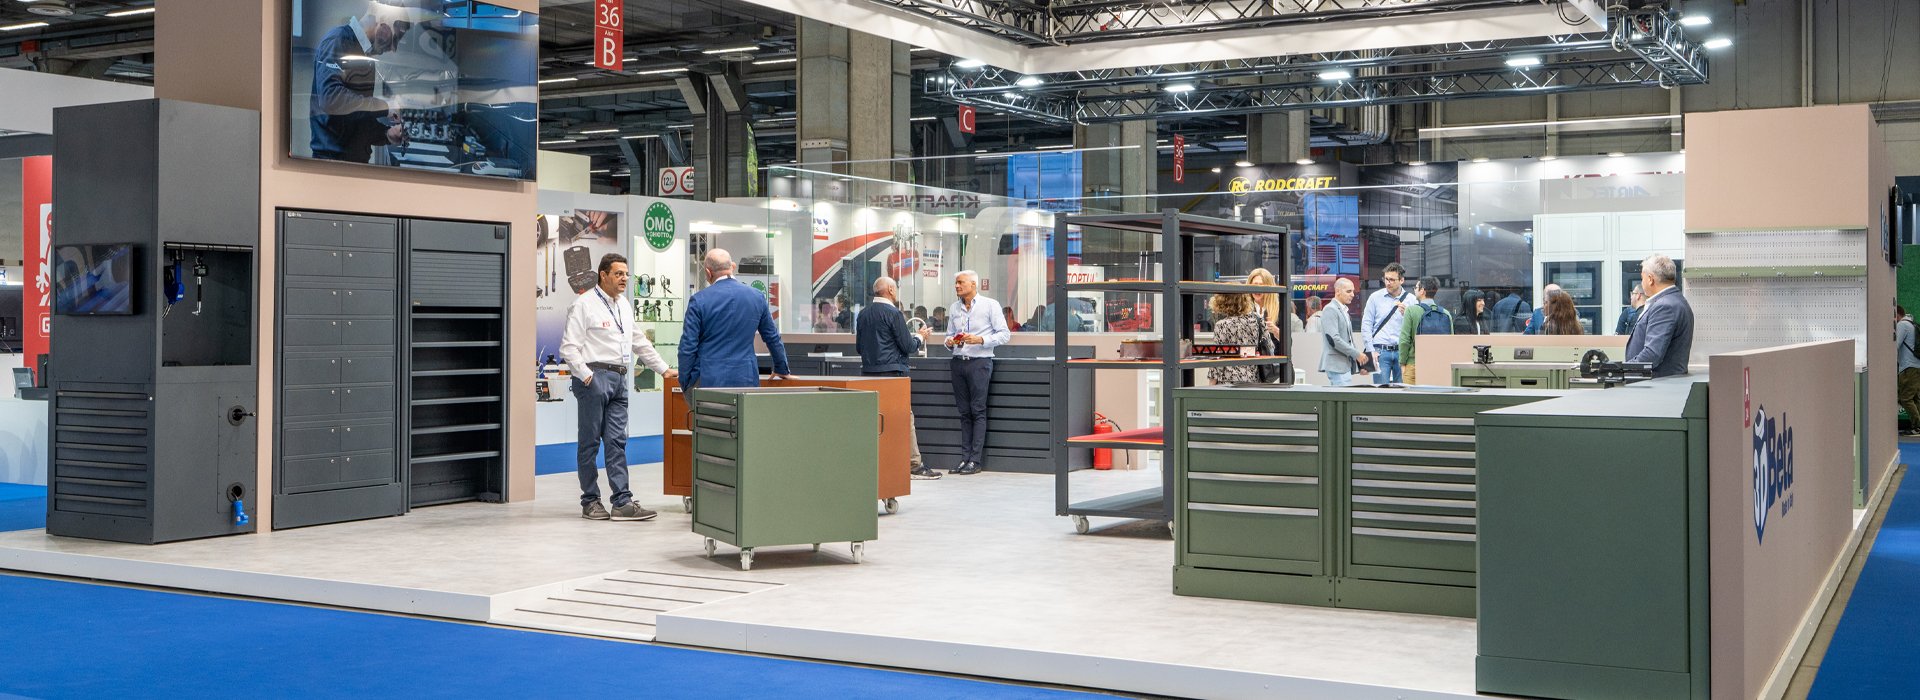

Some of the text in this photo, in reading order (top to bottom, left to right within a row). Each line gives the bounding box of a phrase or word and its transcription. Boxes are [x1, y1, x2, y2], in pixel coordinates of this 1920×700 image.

[600, 3, 620, 27] 36
[603, 37, 616, 67] B
[963, 109, 972, 131] C
[1175, 144, 1184, 158] 36
[1175, 163, 1183, 181] D
[1231, 176, 1333, 193] RC RODCRAFT
[645, 216, 673, 233] OMG
[1767, 411, 1793, 509] Beta
